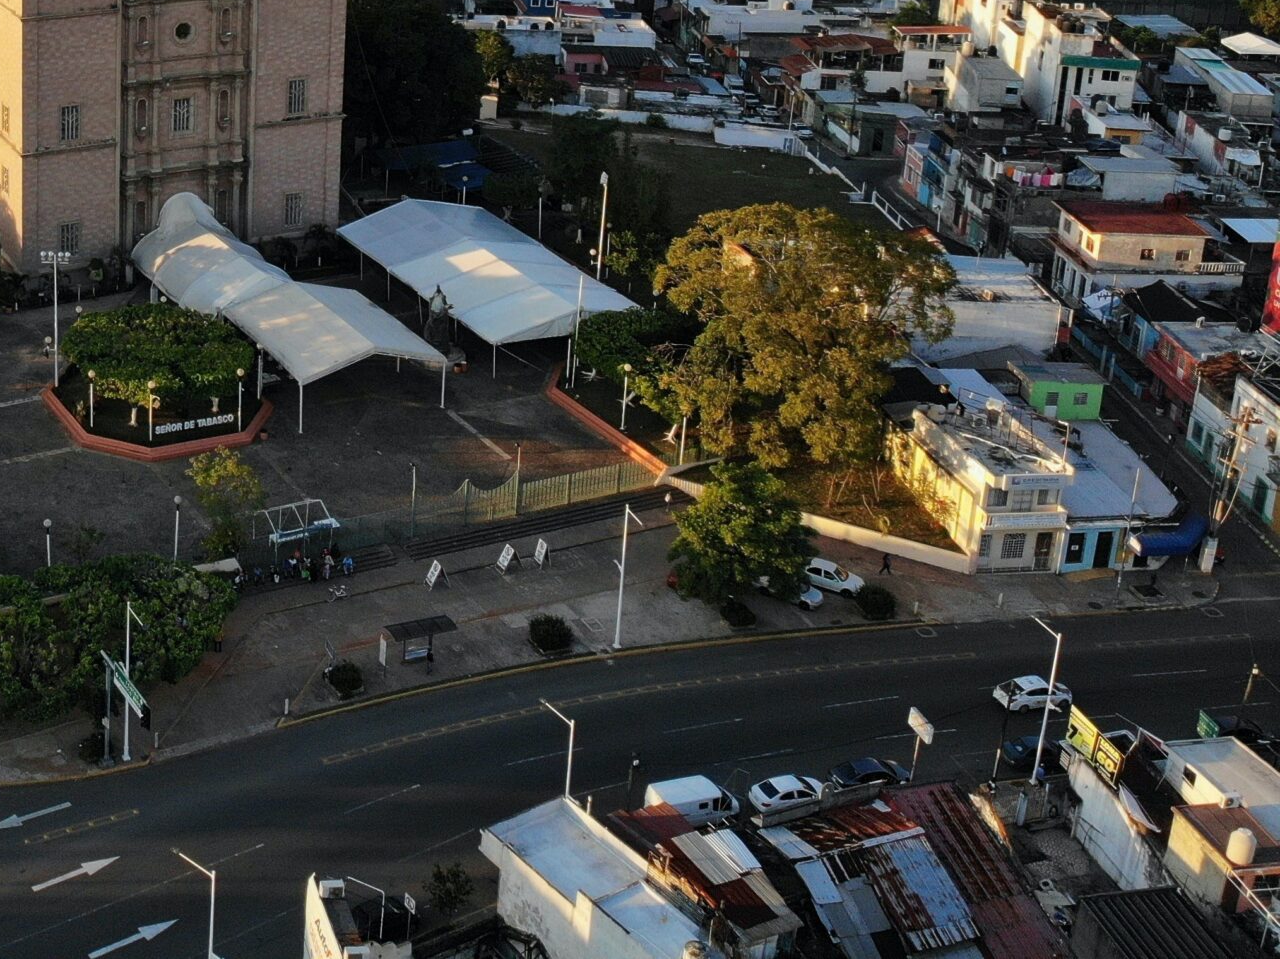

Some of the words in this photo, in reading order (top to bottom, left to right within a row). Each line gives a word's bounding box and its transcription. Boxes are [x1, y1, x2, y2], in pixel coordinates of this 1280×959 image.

[155, 422, 183, 435] SEÑOR
[184, 420, 195, 429] DE
[196, 413, 234, 428] TABASCO
